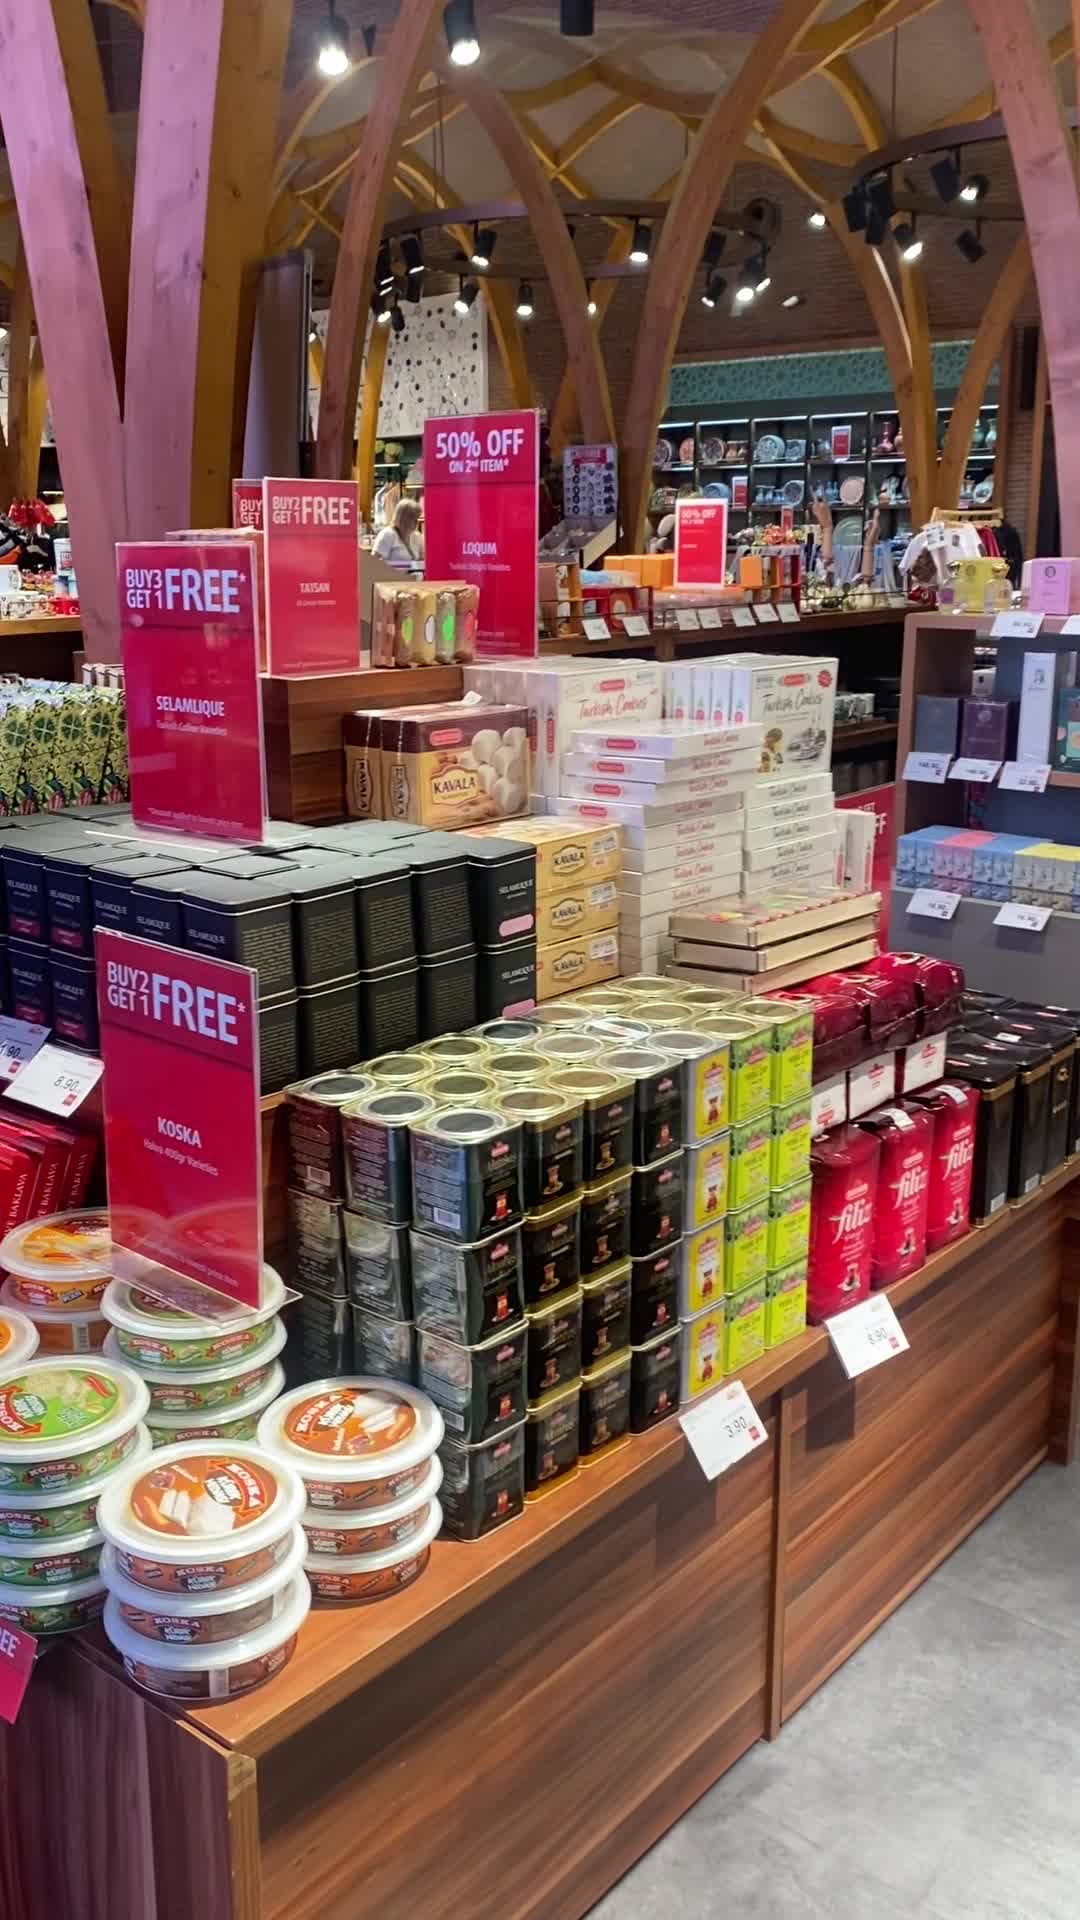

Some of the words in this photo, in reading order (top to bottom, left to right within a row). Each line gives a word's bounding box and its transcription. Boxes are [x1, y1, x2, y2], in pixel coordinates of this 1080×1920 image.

[436, 432, 481, 459] 50%
[487, 428, 525, 457] OFF
[449, 460, 464, 474] ON
[240, 512, 261, 525] GET
[272, 511, 293, 525] GET
[294, 511, 300, 524] 1
[462, 542, 497, 558] LOQUM
[126, 589, 151, 609] GET
[154, 589, 163, 609] 1
[156, 695, 225, 718] SELAMLIQUE
[433, 776, 476, 795] KAVALA
[107, 984, 137, 1012] GET
[139, 994, 149, 1016] 1
[157, 1116, 202, 1148] KOSKA
[39, 1162, 58, 1206] BAKLAVA
[9, 1173, 28, 1217] BAKLAVA
[295, 1394, 343, 1433] KOSKA
[176, 1430, 219, 1440] KOSKA
[723, 1416, 748, 1439] 3.90
[29, 1462, 77, 1477] KOSKA
[225, 1463, 264, 1508] KOSKA
[34, 1557, 81, 1570] KOSKA
[176, 1565, 225, 1577] KOSKA
[153, 1616, 201, 1629] KOSKA
